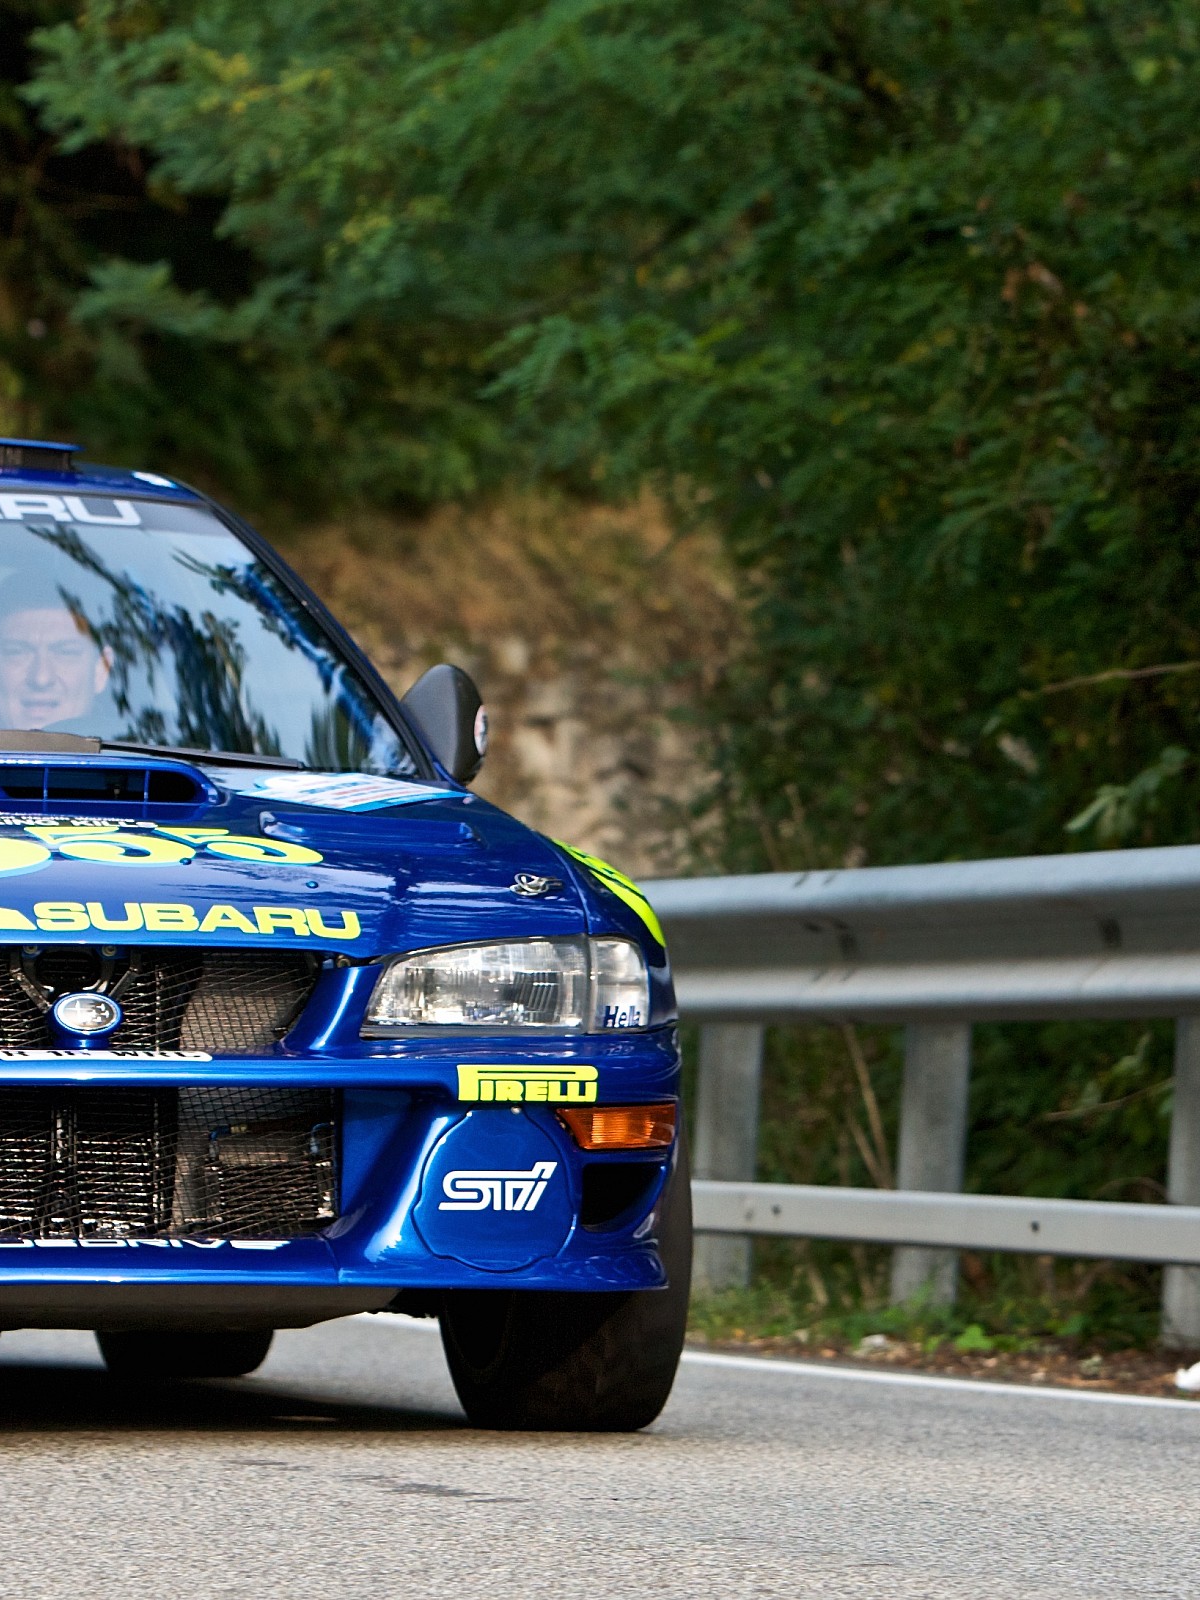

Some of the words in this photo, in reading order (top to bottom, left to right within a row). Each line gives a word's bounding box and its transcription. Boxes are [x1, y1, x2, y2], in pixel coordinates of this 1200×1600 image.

[70, 820, 159, 828] KILLS
[33, 902, 361, 940] SUBARU
[604, 1005, 641, 1029] Hella
[456, 1064, 599, 1103] PIRELLI
